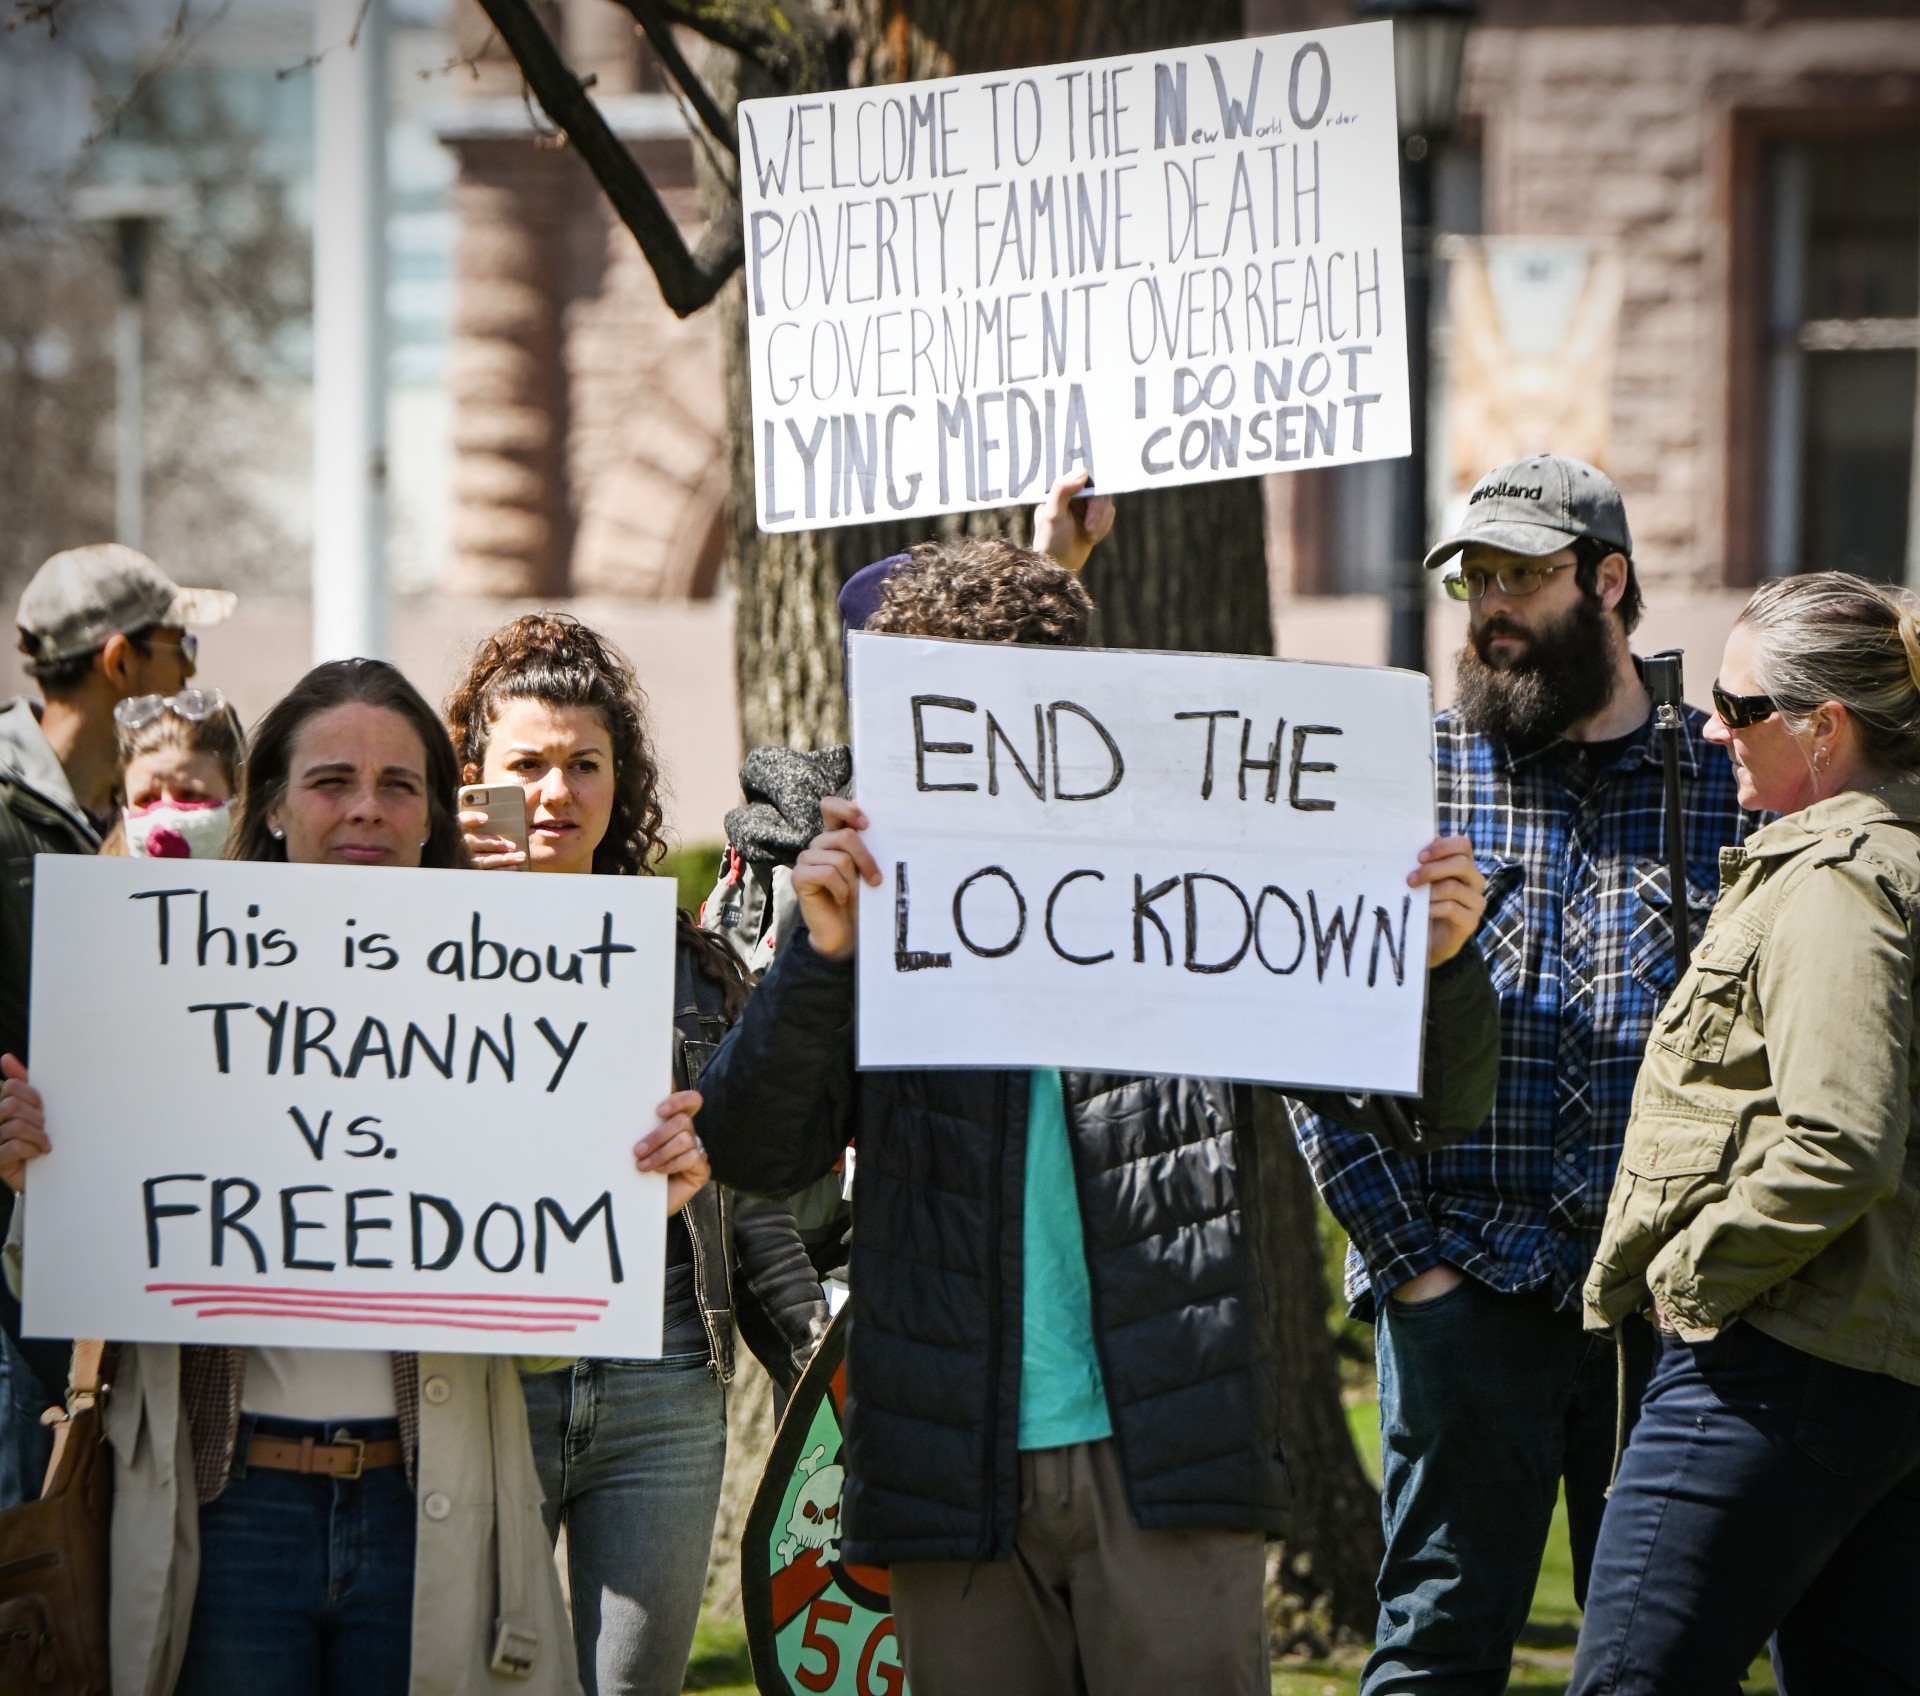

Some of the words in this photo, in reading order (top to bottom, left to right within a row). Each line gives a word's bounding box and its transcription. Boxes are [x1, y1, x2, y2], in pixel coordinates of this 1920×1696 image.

[746, 87, 968, 198] WELCOME
[981, 79, 1041, 170] TO
[1056, 66, 1140, 161] THE
[751, 188, 964, 316] POVERTY,
[1164, 140, 1320, 264] DEATH
[768, 281, 1108, 405] GOVERNMENT
[1135, 376, 1146, 419] I
[1174, 364, 1236, 416] DO
[1255, 345, 1373, 405] NOT
[765, 405, 923, 524] LYING
[937, 382, 1095, 504] MEDIA
[1141, 393, 1383, 475] CONSENT
[911, 694, 1125, 802] END
[1174, 709, 1343, 811] THE
[129, 888, 298, 969] This
[344, 919, 399, 969] is
[427, 911, 637, 988] about
[895, 861, 1412, 988] LOCKDOWN
[188, 1000, 588, 1092] TYRANNY
[142, 1174, 624, 1284] FREEDOM
[795, 1598, 905, 1696] 5G
